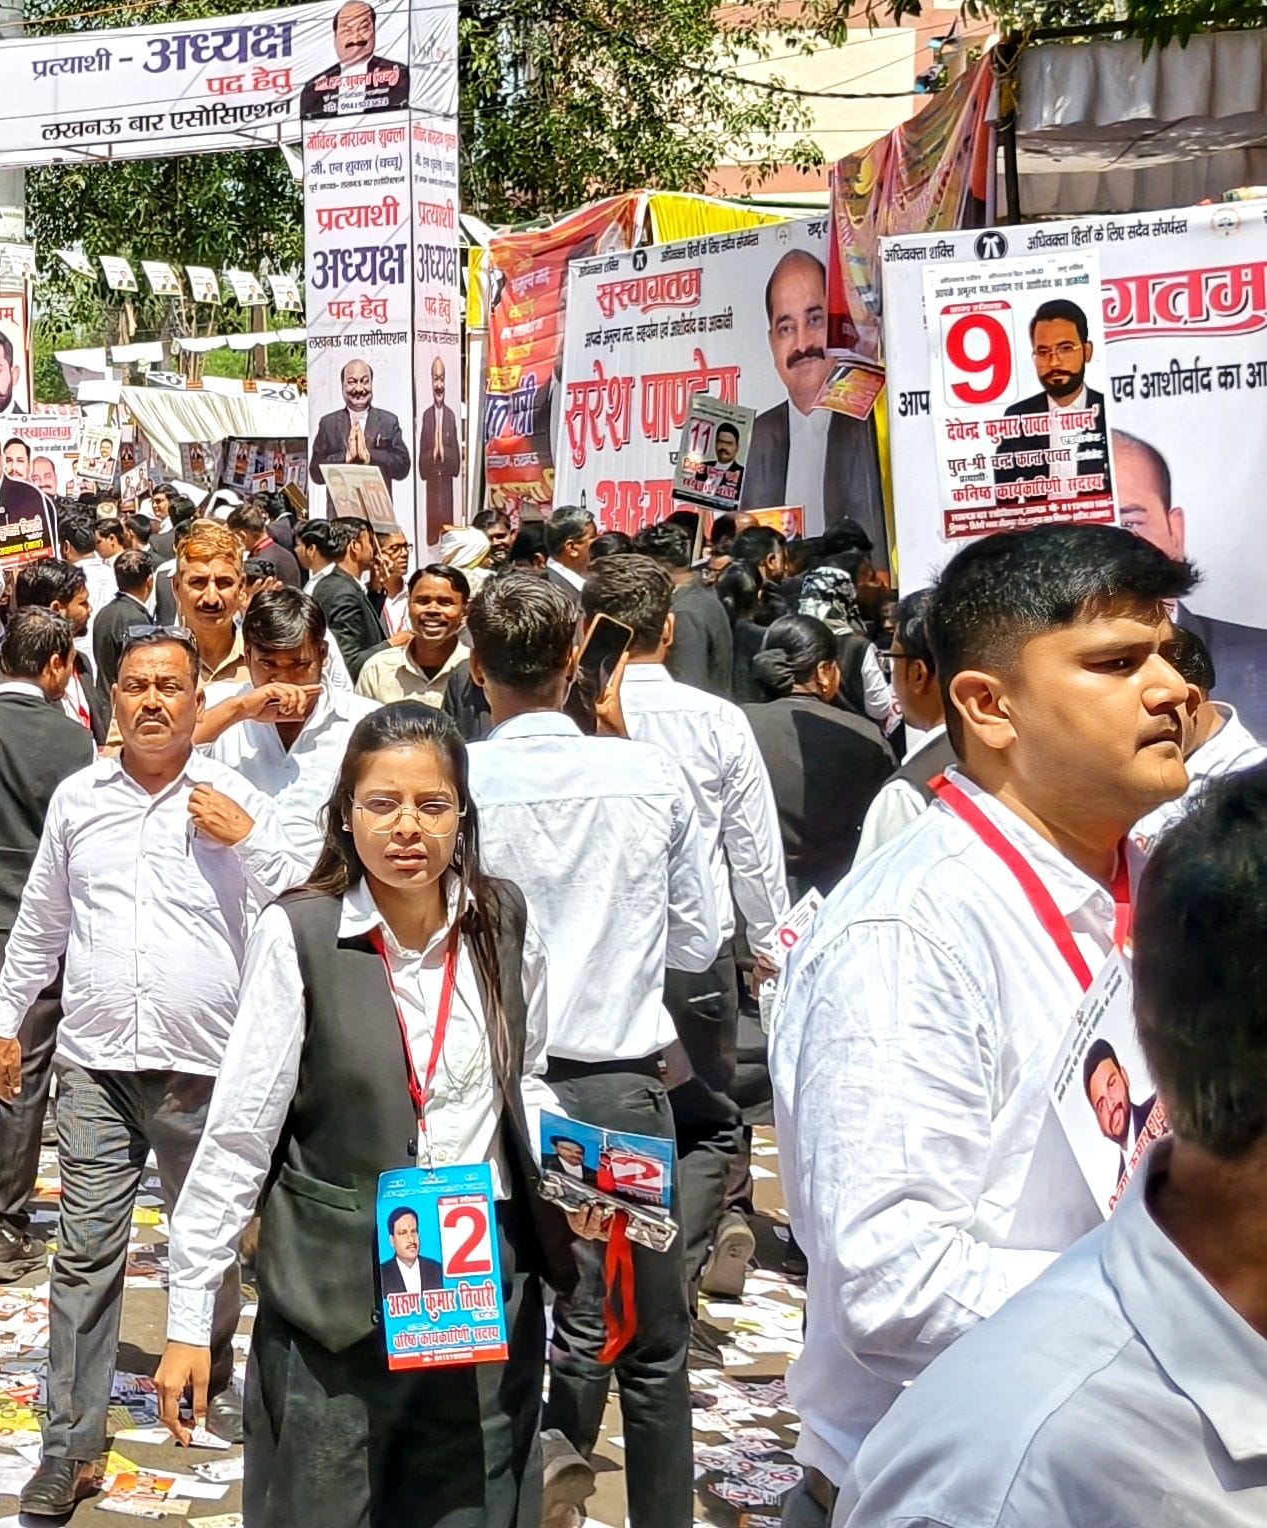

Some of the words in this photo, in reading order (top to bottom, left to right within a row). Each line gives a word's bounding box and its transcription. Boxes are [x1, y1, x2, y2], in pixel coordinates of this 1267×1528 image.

[32, 47, 112, 81] प्रत्याशी
[142, 20, 297, 73] अध्यक्ष
[206, 75, 247, 96] पद
[253, 66, 293, 94] हेतु
[42, 115, 122, 141] लखनऊ
[128, 112, 164, 134] बार
[170, 98, 292, 130] एसोसिएशन
[316, 195, 400, 234] प्रत्याशी
[418, 199, 454, 229] प्रत्याशी
[1027, 230, 1069, 250] अधिवक्ता
[1071, 224, 1093, 246] हितों
[1094, 225, 1105, 242] के
[1106, 223, 1125, 242] लिए
[1127, 219, 1150, 240] सदैव
[311, 244, 407, 289] अध्यक्ष
[417, 244, 457, 286] अध्यक्ष
[884, 243, 927, 264] अधिवक्ता
[929, 242, 955, 260] शक्ति
[328, 301, 355, 319] पद
[360, 294, 388, 324] हेतु
[309, 334, 342, 349] लखनऊ
[344, 333, 358, 347] बार
[946, 314, 1012, 404] 9
[898, 390, 930, 417] आप
[1111, 364, 1136, 402] एवं
[1140, 356, 1212, 399] आशीर्वाद
[1217, 363, 1241, 390] का
[565, 359, 635, 470] सुरेश
[946, 418, 979, 440] देवेन्द्र
[984, 417, 1019, 444] कुमार
[1022, 414, 1049, 433] रावत
[690, 423, 712, 456] 11
[1044, 449, 1071, 463] रावत
[951, 484, 992, 501] कनिष्ठ
[1067, 474, 1104, 491] सदस्य
[612, 1156, 661, 1187] 2
[443, 1206, 491, 1275] 2
[424, 1290, 455, 1320] कुमार
[459, 1281, 496, 1309] तिवारी
